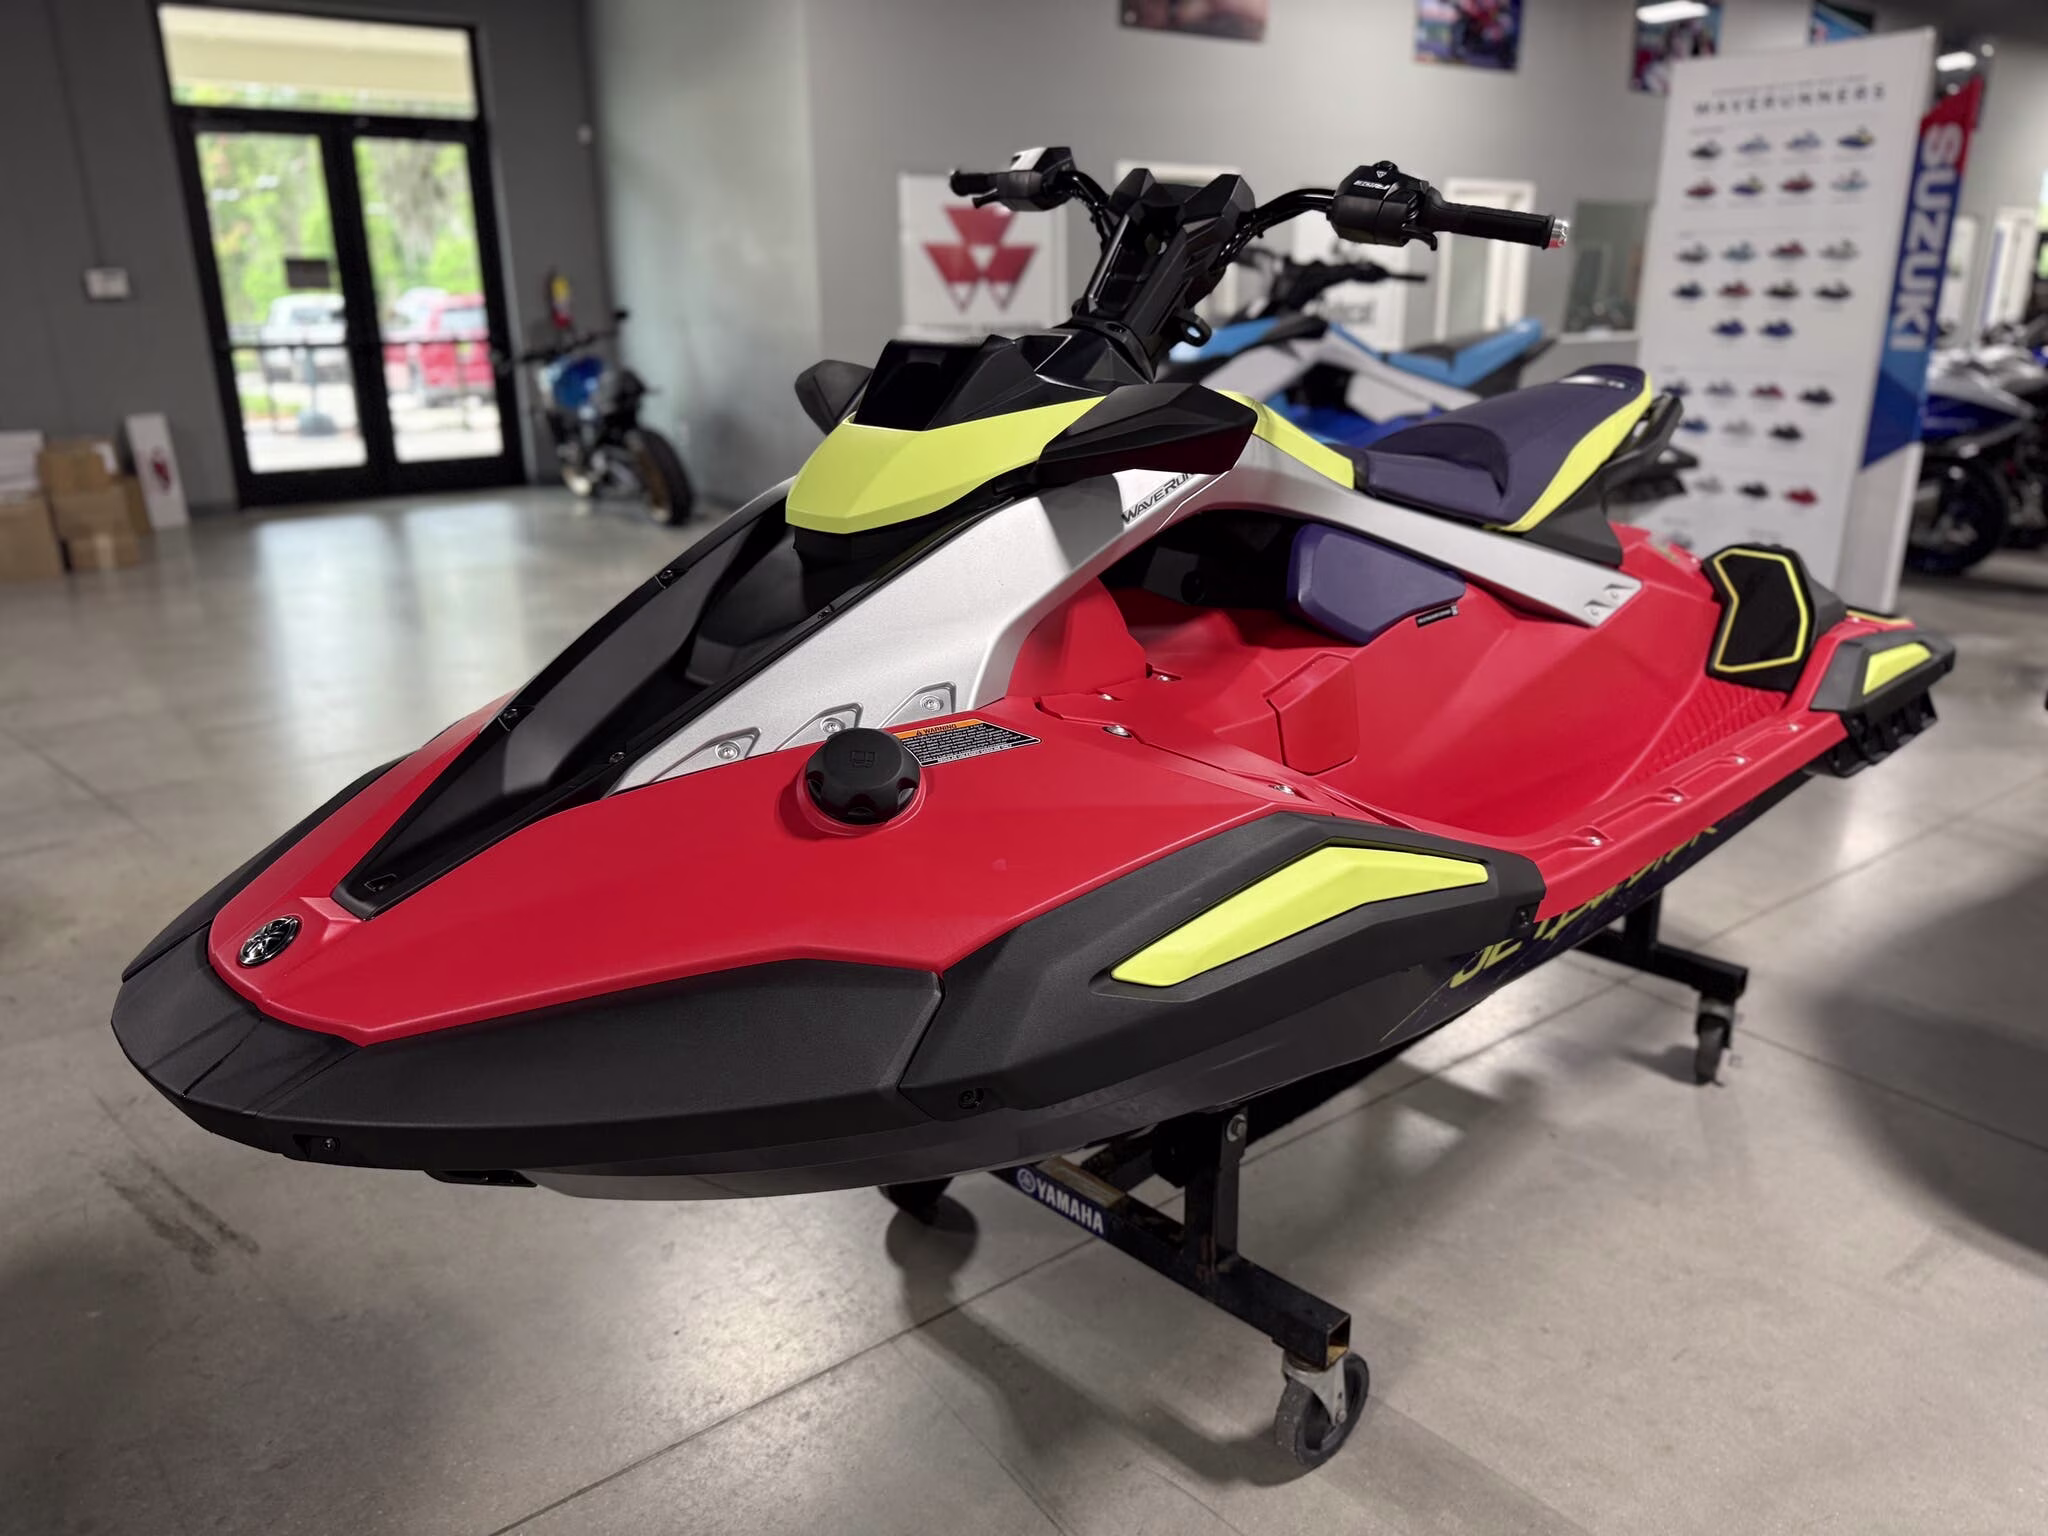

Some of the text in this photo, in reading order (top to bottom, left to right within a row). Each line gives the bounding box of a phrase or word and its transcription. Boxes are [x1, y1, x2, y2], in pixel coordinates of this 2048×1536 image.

[1890, 121, 1965, 351] SUZUKI
[923, 723, 957, 735] WARNING
[1036, 1177, 1104, 1235] YAMAHA
